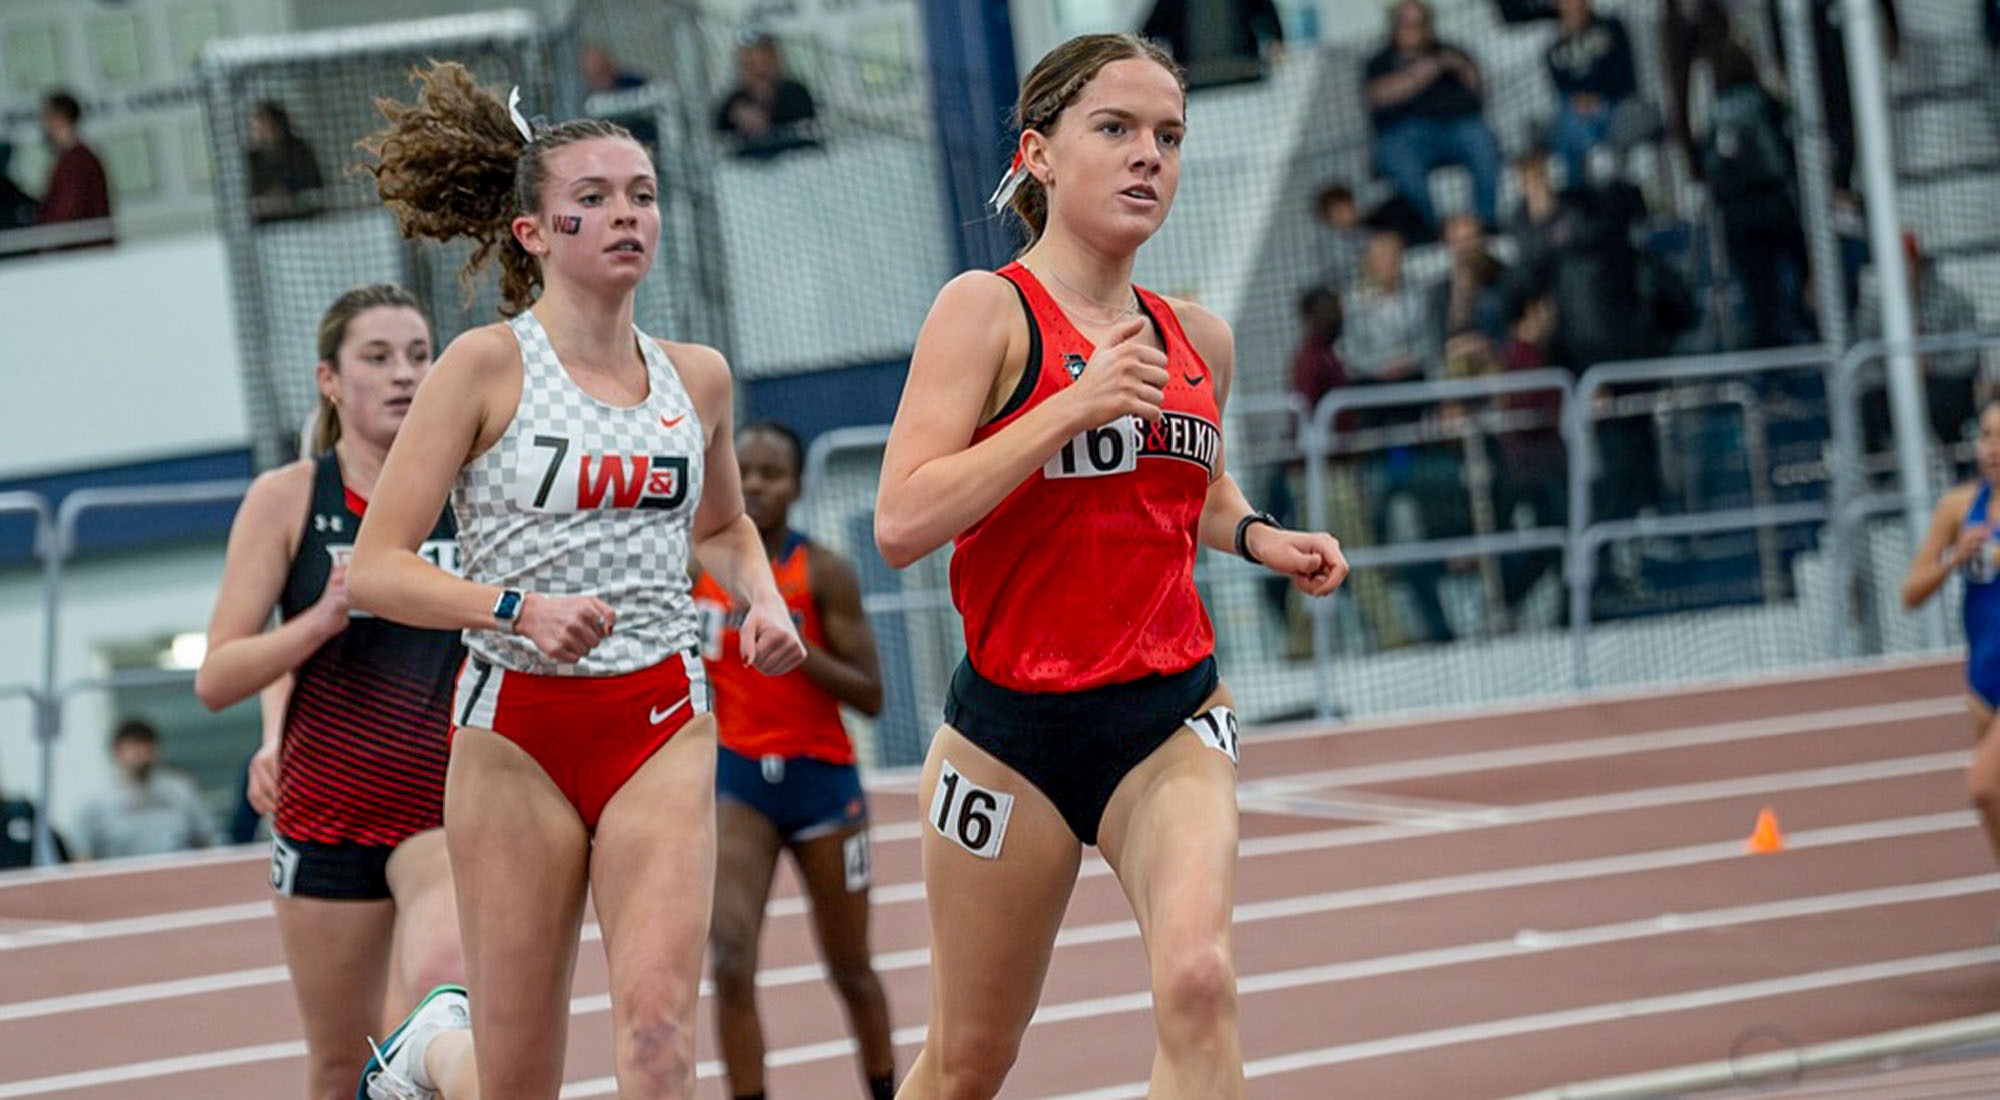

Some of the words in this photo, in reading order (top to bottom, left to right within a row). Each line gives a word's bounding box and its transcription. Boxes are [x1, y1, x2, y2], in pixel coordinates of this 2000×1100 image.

[533, 435, 569, 509] 7
[576, 455, 689, 510] W&J
[1062, 427, 1123, 474] 16
[461, 657, 493, 727] 7
[937, 772, 996, 851] 16
